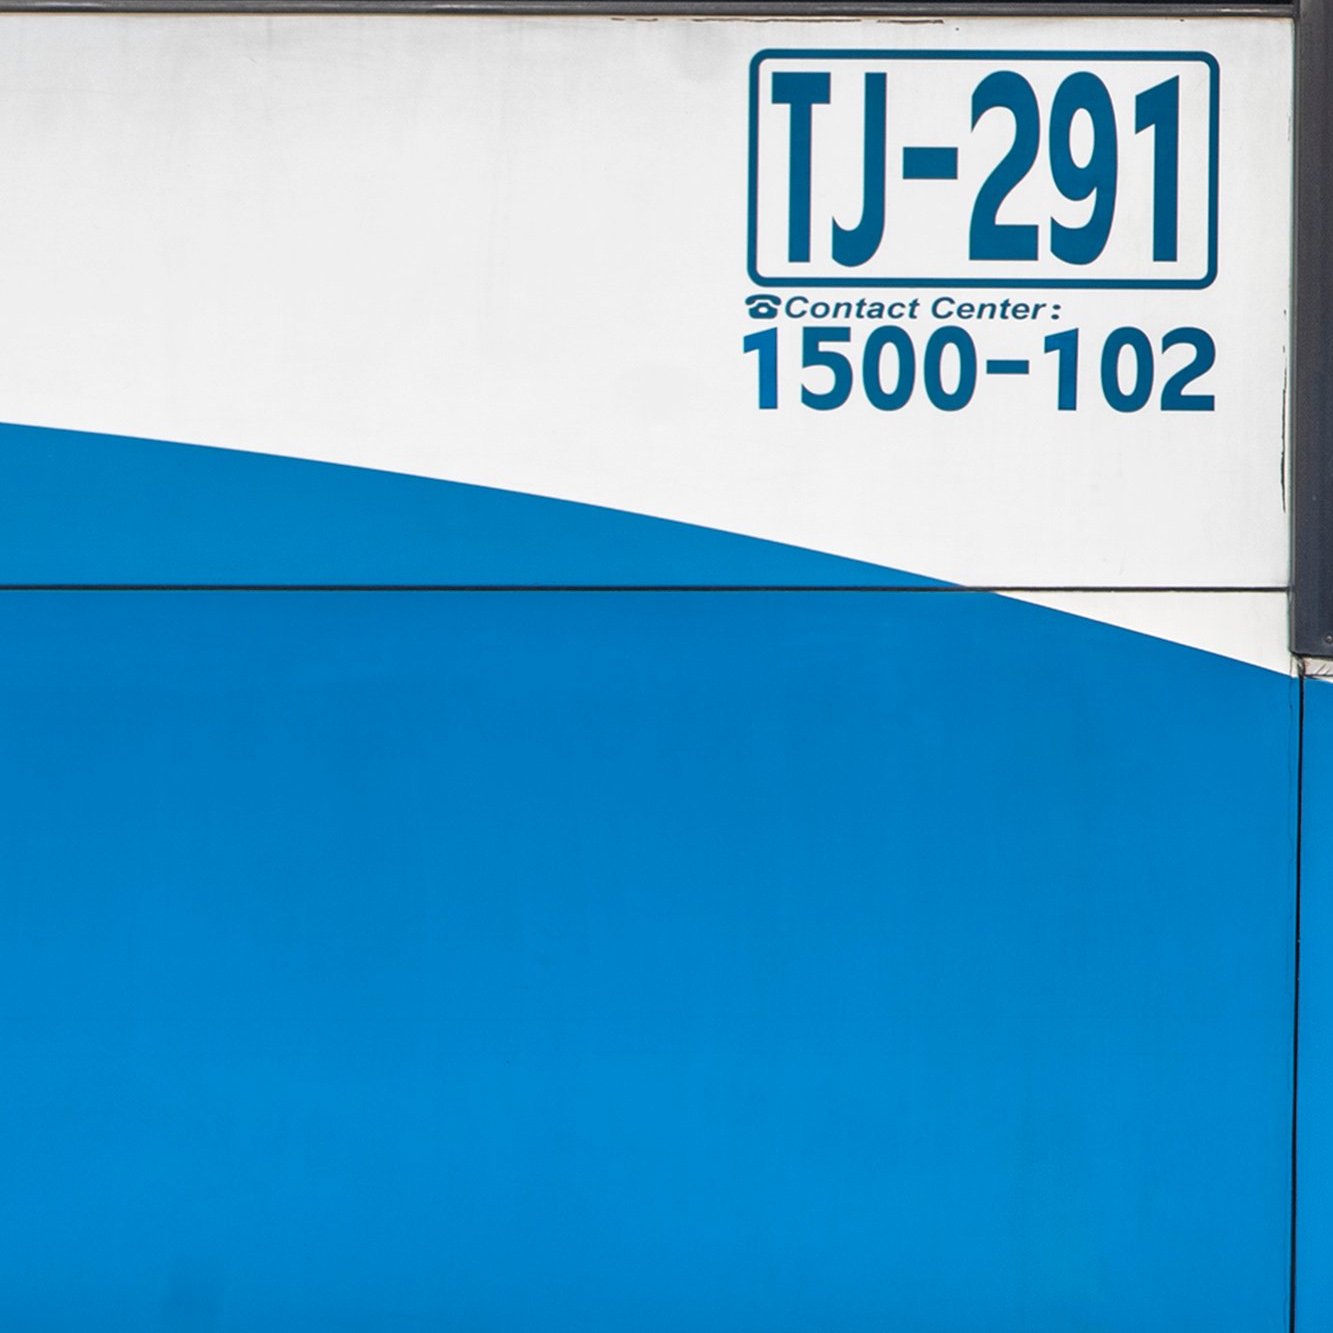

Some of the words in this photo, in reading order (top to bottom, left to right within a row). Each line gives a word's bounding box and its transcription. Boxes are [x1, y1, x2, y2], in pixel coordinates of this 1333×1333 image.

[771, 70, 1180, 268] TJ-291
[784, 296, 919, 321] Contact
[931, 296, 1062, 321] Center:
[742, 325, 1216, 413] 1500-102
